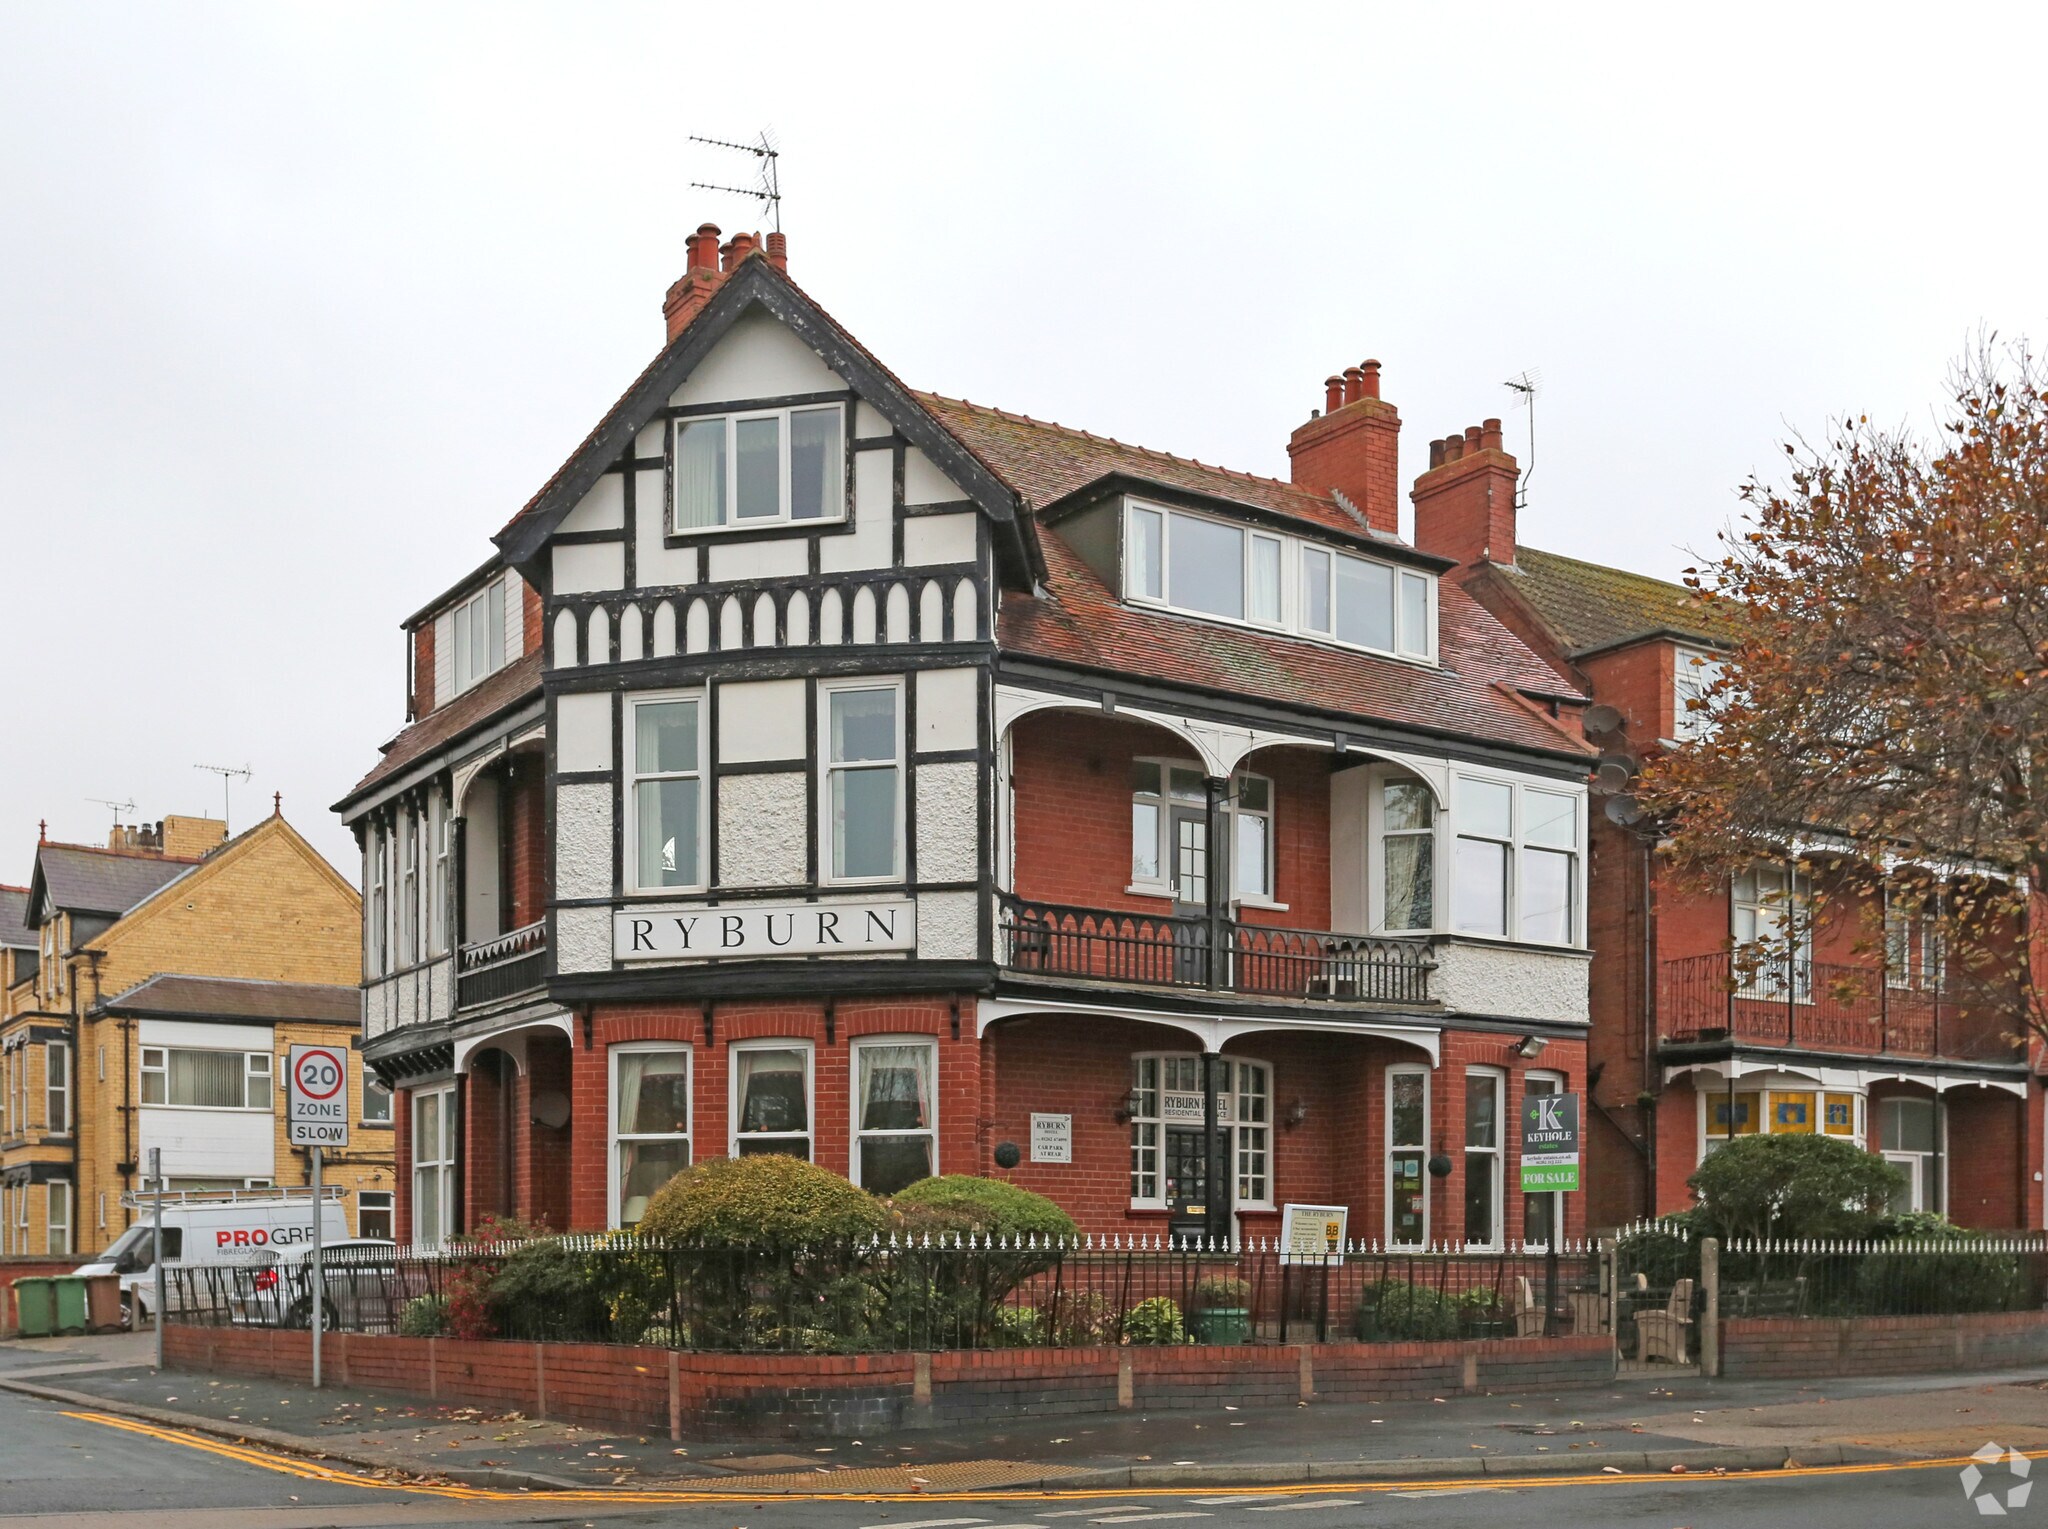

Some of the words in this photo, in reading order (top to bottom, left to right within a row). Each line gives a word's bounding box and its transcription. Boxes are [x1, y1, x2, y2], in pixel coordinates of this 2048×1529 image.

[630, 908, 897, 951] RYBURN
[303, 1065, 337, 1086] 20
[1164, 1096, 1200, 1109] RYBURN
[297, 1103, 342, 1117] ZONE
[1164, 1109, 1202, 1117] RESIDENTIAL
[1537, 1098, 1563, 1130] K
[1036, 1121, 1066, 1129] RYBURN
[296, 1126, 343, 1140] SLOW
[1527, 1131, 1572, 1142] KEYHOLE
[1523, 1174, 1545, 1184] FOR
[1546, 1172, 1576, 1184] SALE
